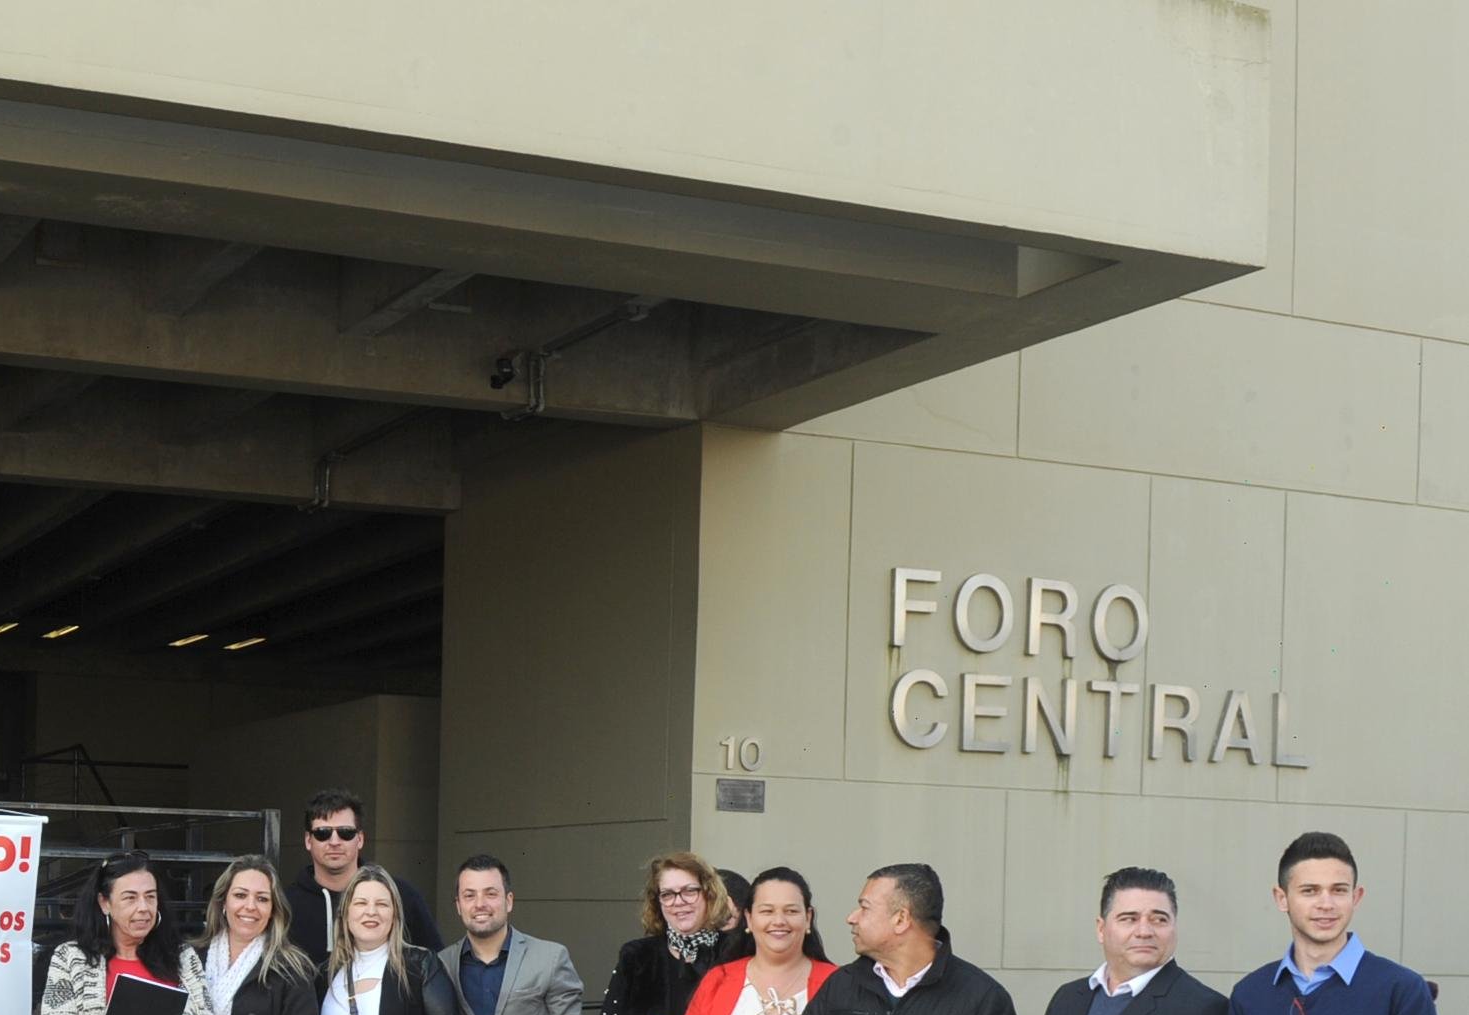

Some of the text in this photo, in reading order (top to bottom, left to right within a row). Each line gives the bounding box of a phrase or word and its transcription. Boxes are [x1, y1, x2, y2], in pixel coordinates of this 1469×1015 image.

[890, 567, 1149, 662] FORO
[719, 735, 764, 772] 10
[889, 668, 1313, 770] CENTRAL
